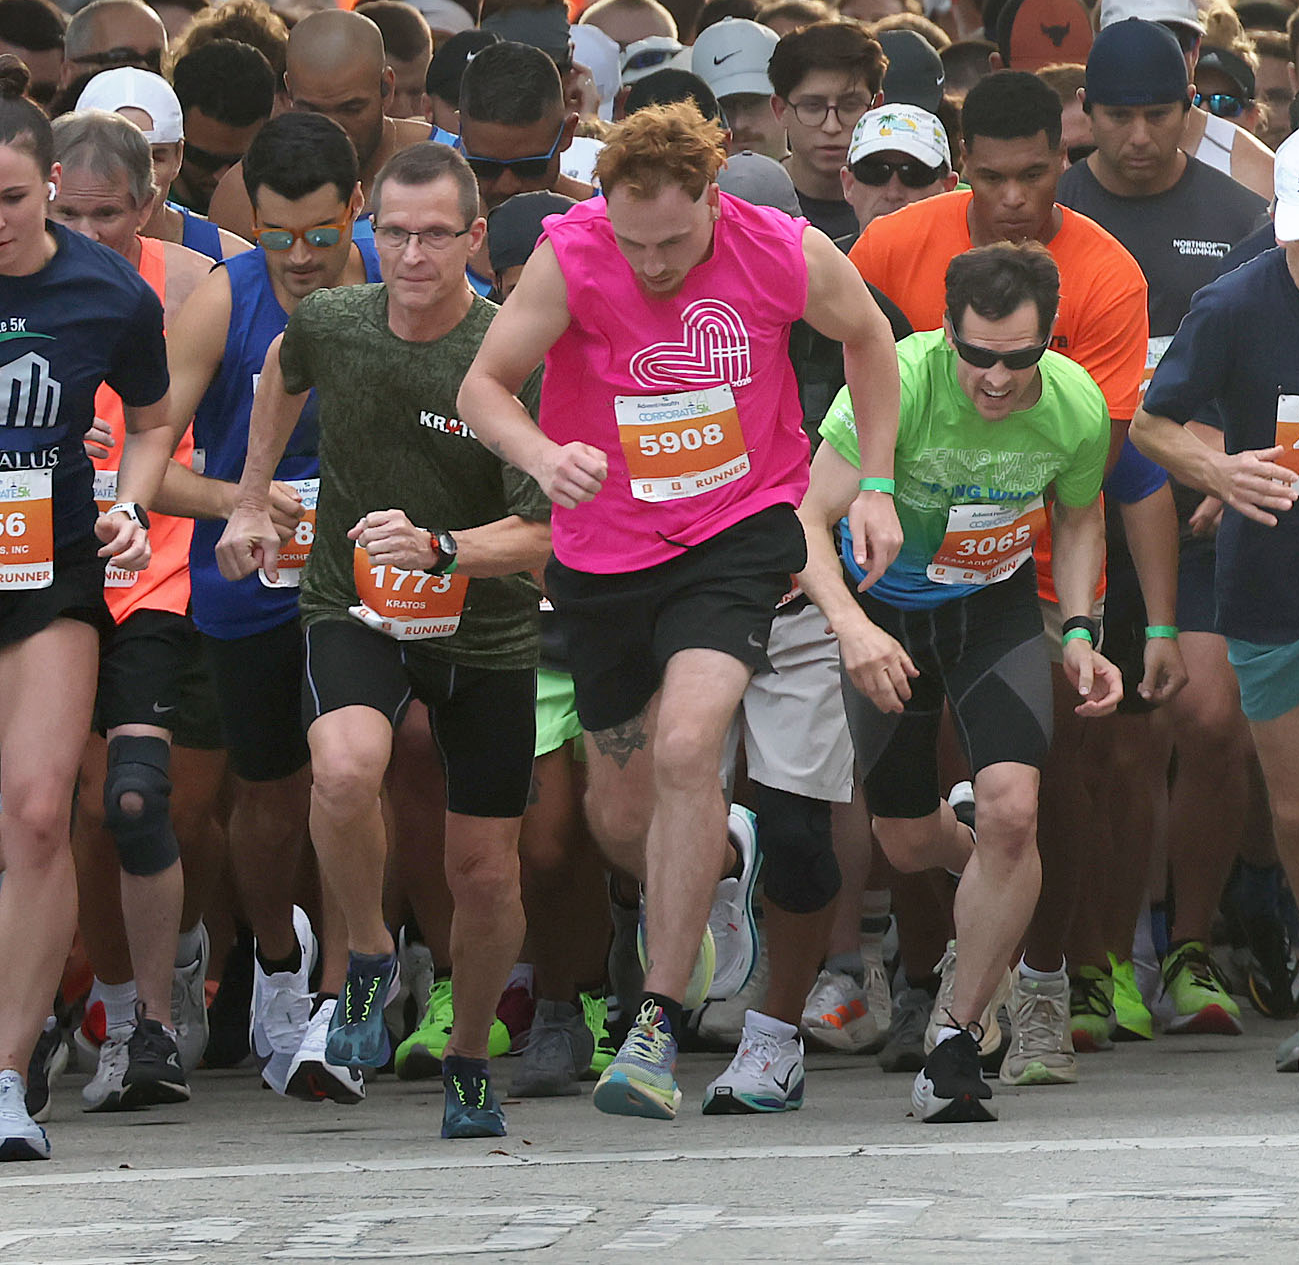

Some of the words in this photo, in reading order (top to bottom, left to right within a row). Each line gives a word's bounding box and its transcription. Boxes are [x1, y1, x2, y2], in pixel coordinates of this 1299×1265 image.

[1173, 239, 1218, 249] NORTHROP
[1179, 246, 1224, 257] GRUMMAN
[10, 317, 27, 332] 5K
[639, 407, 698, 422] CORPORATE
[639, 423, 724, 456] 5908
[695, 461, 748, 489] RUNNER
[956, 525, 1031, 557] 3065
[385, 598, 427, 610] KRATOS
[404, 623, 457, 635] RUNNER
